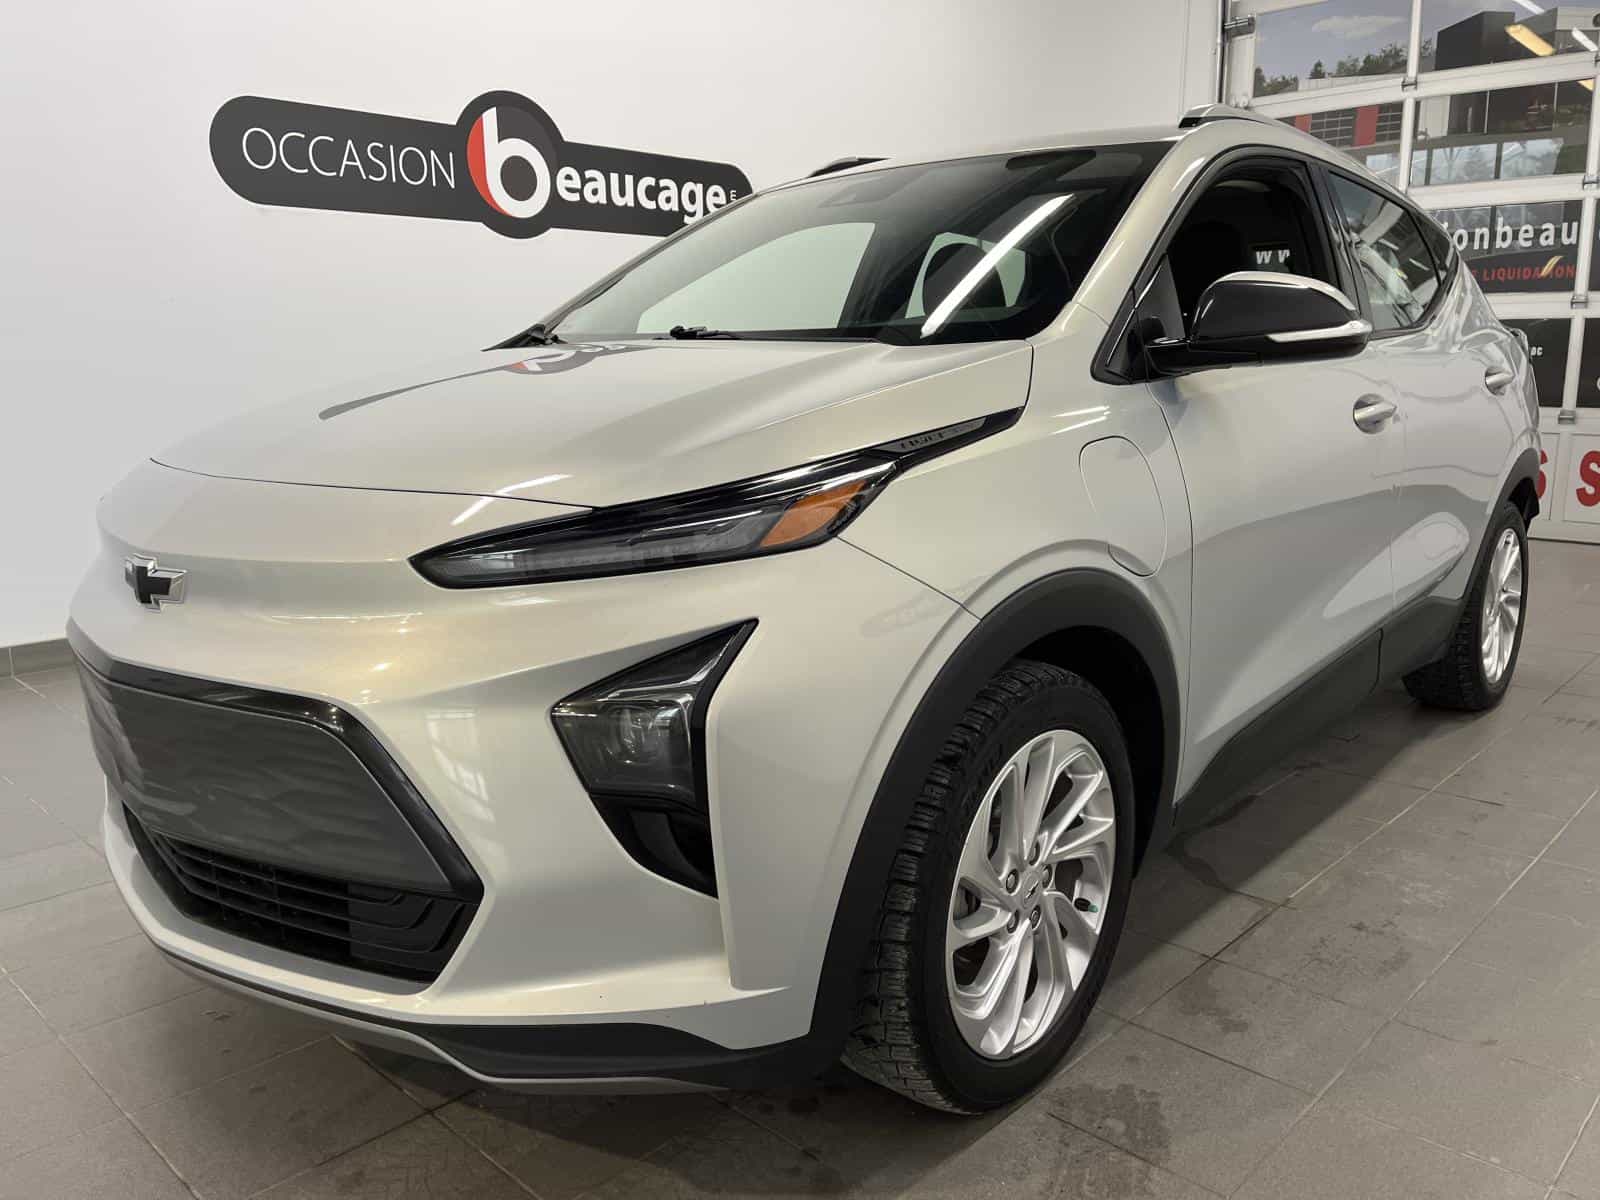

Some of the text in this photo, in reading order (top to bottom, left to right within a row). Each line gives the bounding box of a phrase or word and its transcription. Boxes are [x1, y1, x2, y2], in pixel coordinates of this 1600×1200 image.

[242, 127, 456, 189] OCCASION
[1442, 216, 1579, 251] onbeau
[1483, 264, 1576, 282] LIQUIDAION
